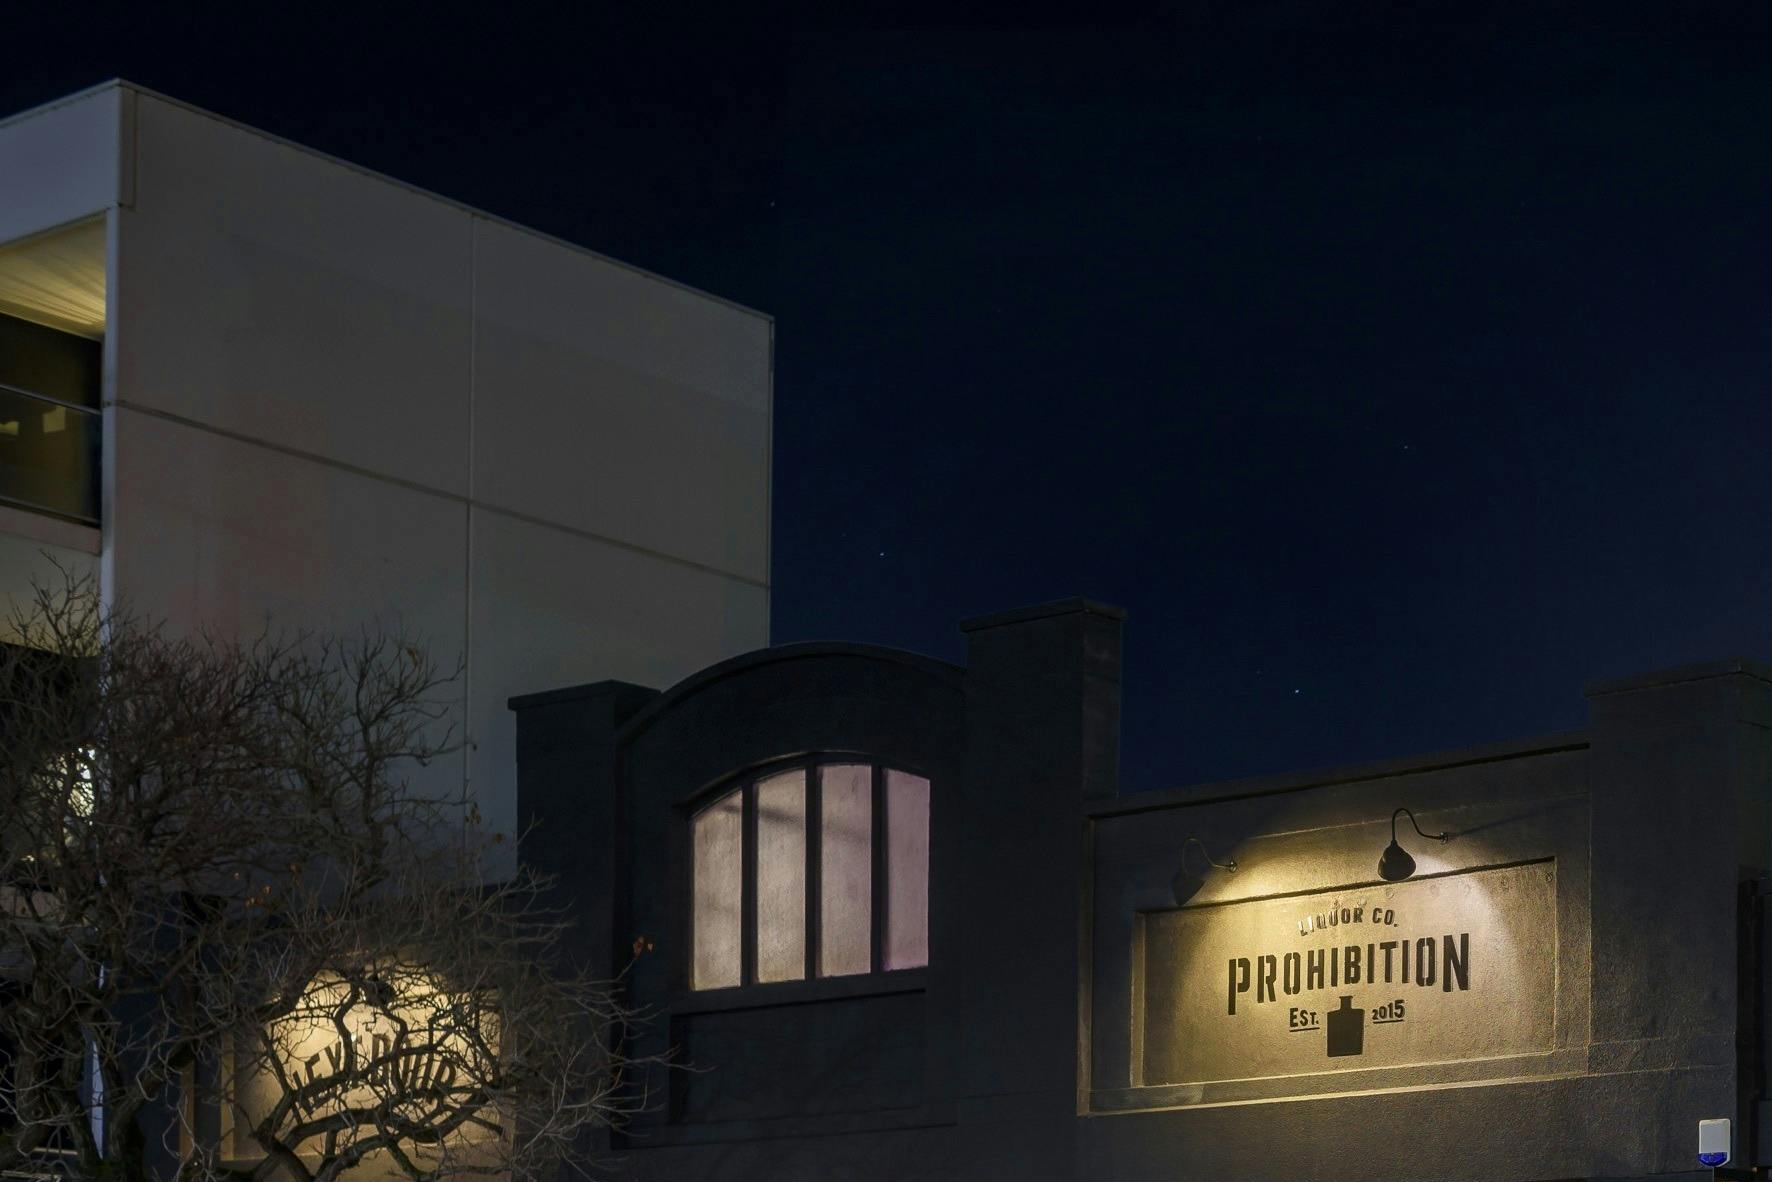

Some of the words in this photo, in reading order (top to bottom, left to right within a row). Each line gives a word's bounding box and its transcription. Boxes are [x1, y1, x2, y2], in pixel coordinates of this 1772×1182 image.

[1298, 908, 1363, 936] LIQUOR
[1372, 908, 1399, 927] CO.
[1228, 932, 1470, 1015] PROHIBITION
[1372, 1000, 1405, 1021] 2015
[290, 1035, 363, 1113] EXT
